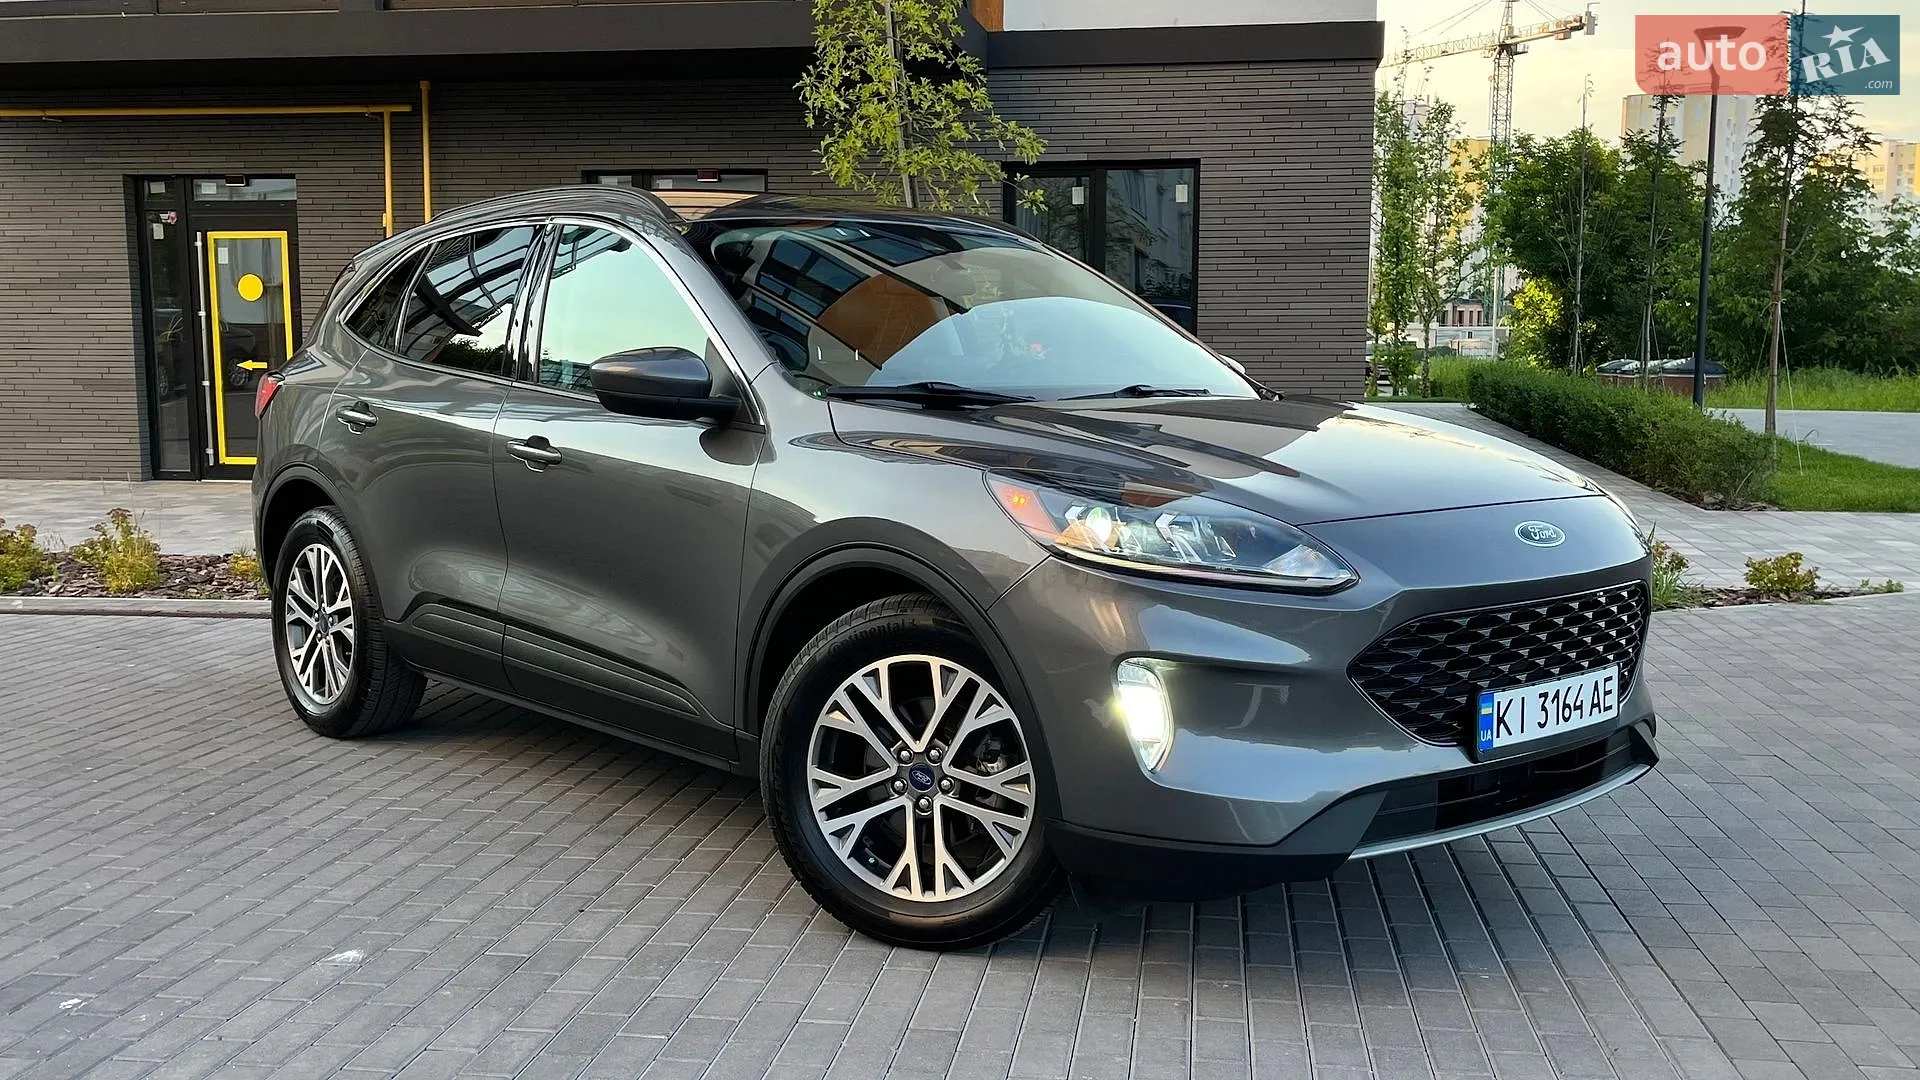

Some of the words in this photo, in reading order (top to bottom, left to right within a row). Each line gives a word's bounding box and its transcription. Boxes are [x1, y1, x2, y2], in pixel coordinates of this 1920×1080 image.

[1528, 525, 1557, 541] Ford
[1496, 696, 1525, 739] KI
[1537, 683, 1584, 729] 3164
[1588, 675, 1613, 717] AE
[1480, 730, 1492, 742] UA
